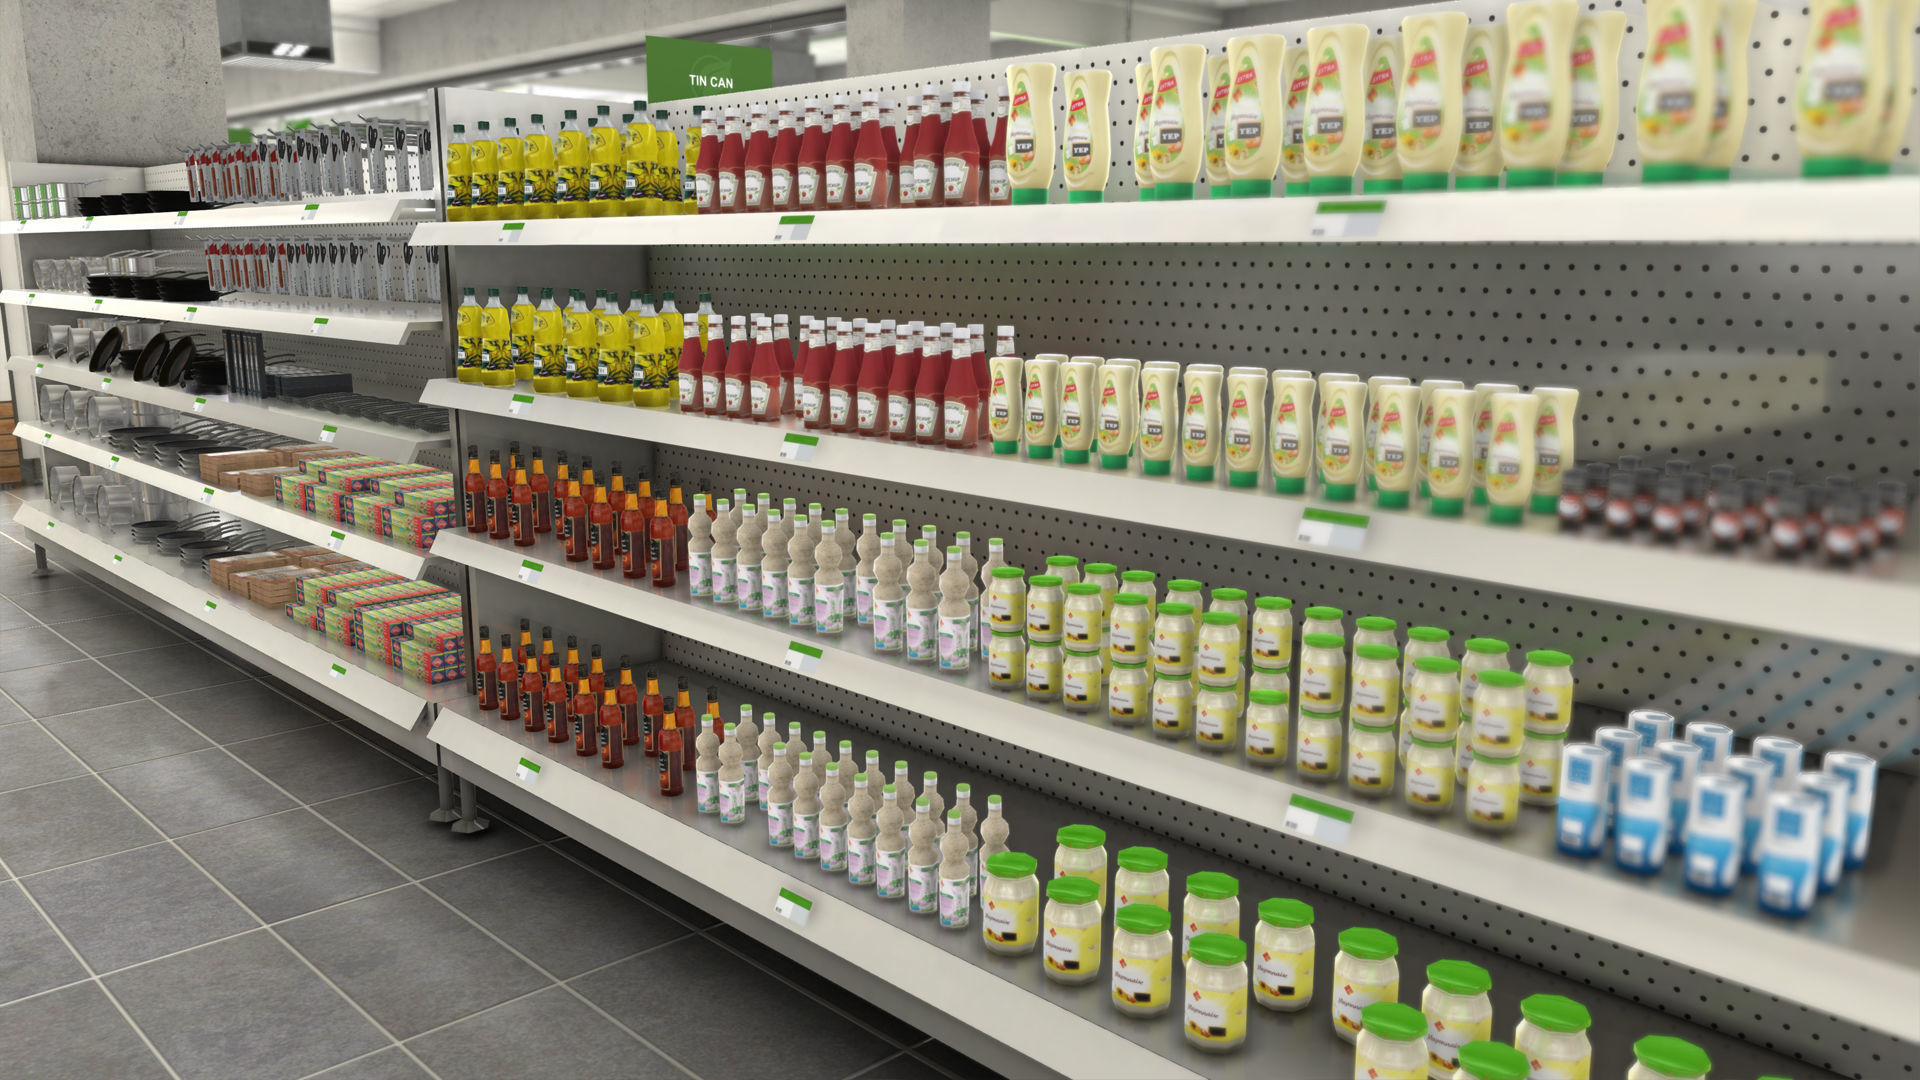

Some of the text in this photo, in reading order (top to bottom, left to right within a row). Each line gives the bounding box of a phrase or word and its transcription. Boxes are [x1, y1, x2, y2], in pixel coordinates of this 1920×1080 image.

[689, 74, 734, 89] TIN CAN
[1416, 114, 1438, 123] YEP
[1320, 121, 1341, 130] YEP
[1468, 121, 1490, 130] YEP
[1240, 127, 1259, 135] YEP
[1374, 127, 1394, 135] YEP
[1162, 132, 1179, 140] YEP
